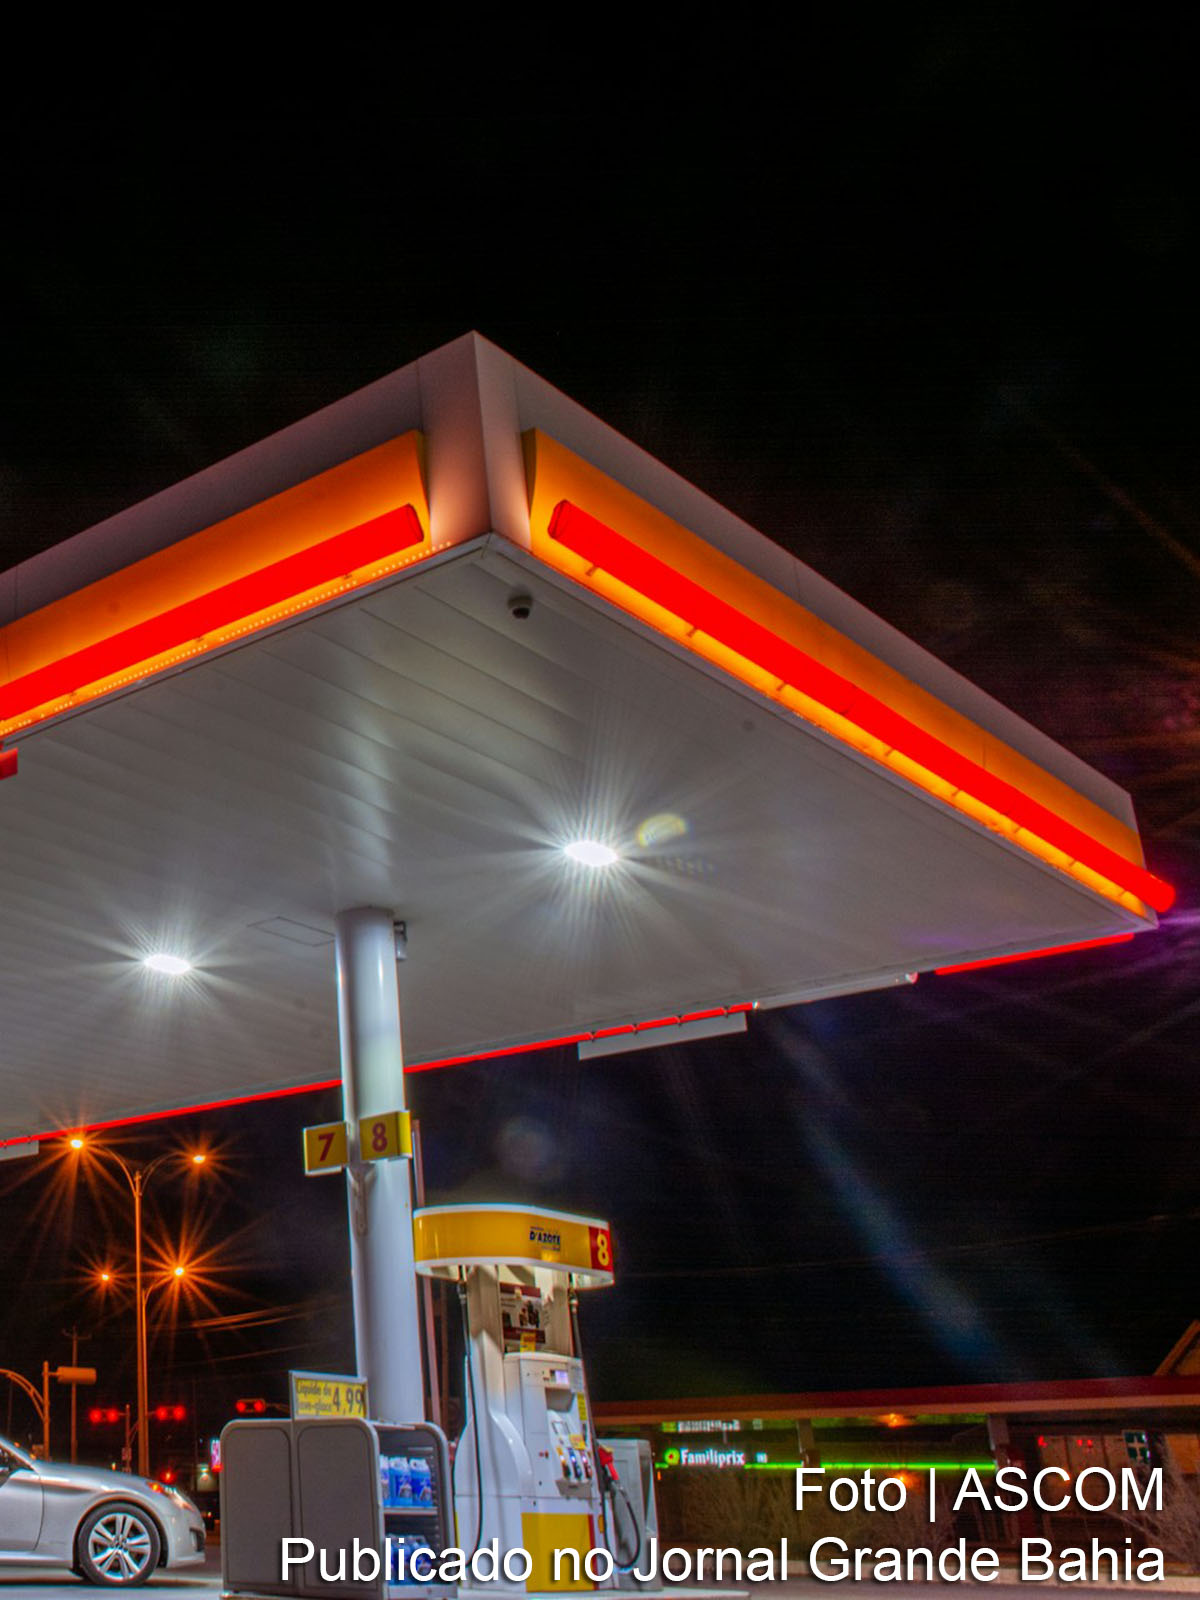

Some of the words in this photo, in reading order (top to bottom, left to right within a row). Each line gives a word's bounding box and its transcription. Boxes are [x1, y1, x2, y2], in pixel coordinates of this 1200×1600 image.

[318, 1133, 335, 1162] 7
[372, 1122, 387, 1152] 8
[597, 1234, 609, 1266] 8
[680, 1448, 745, 1468] Familiprix
